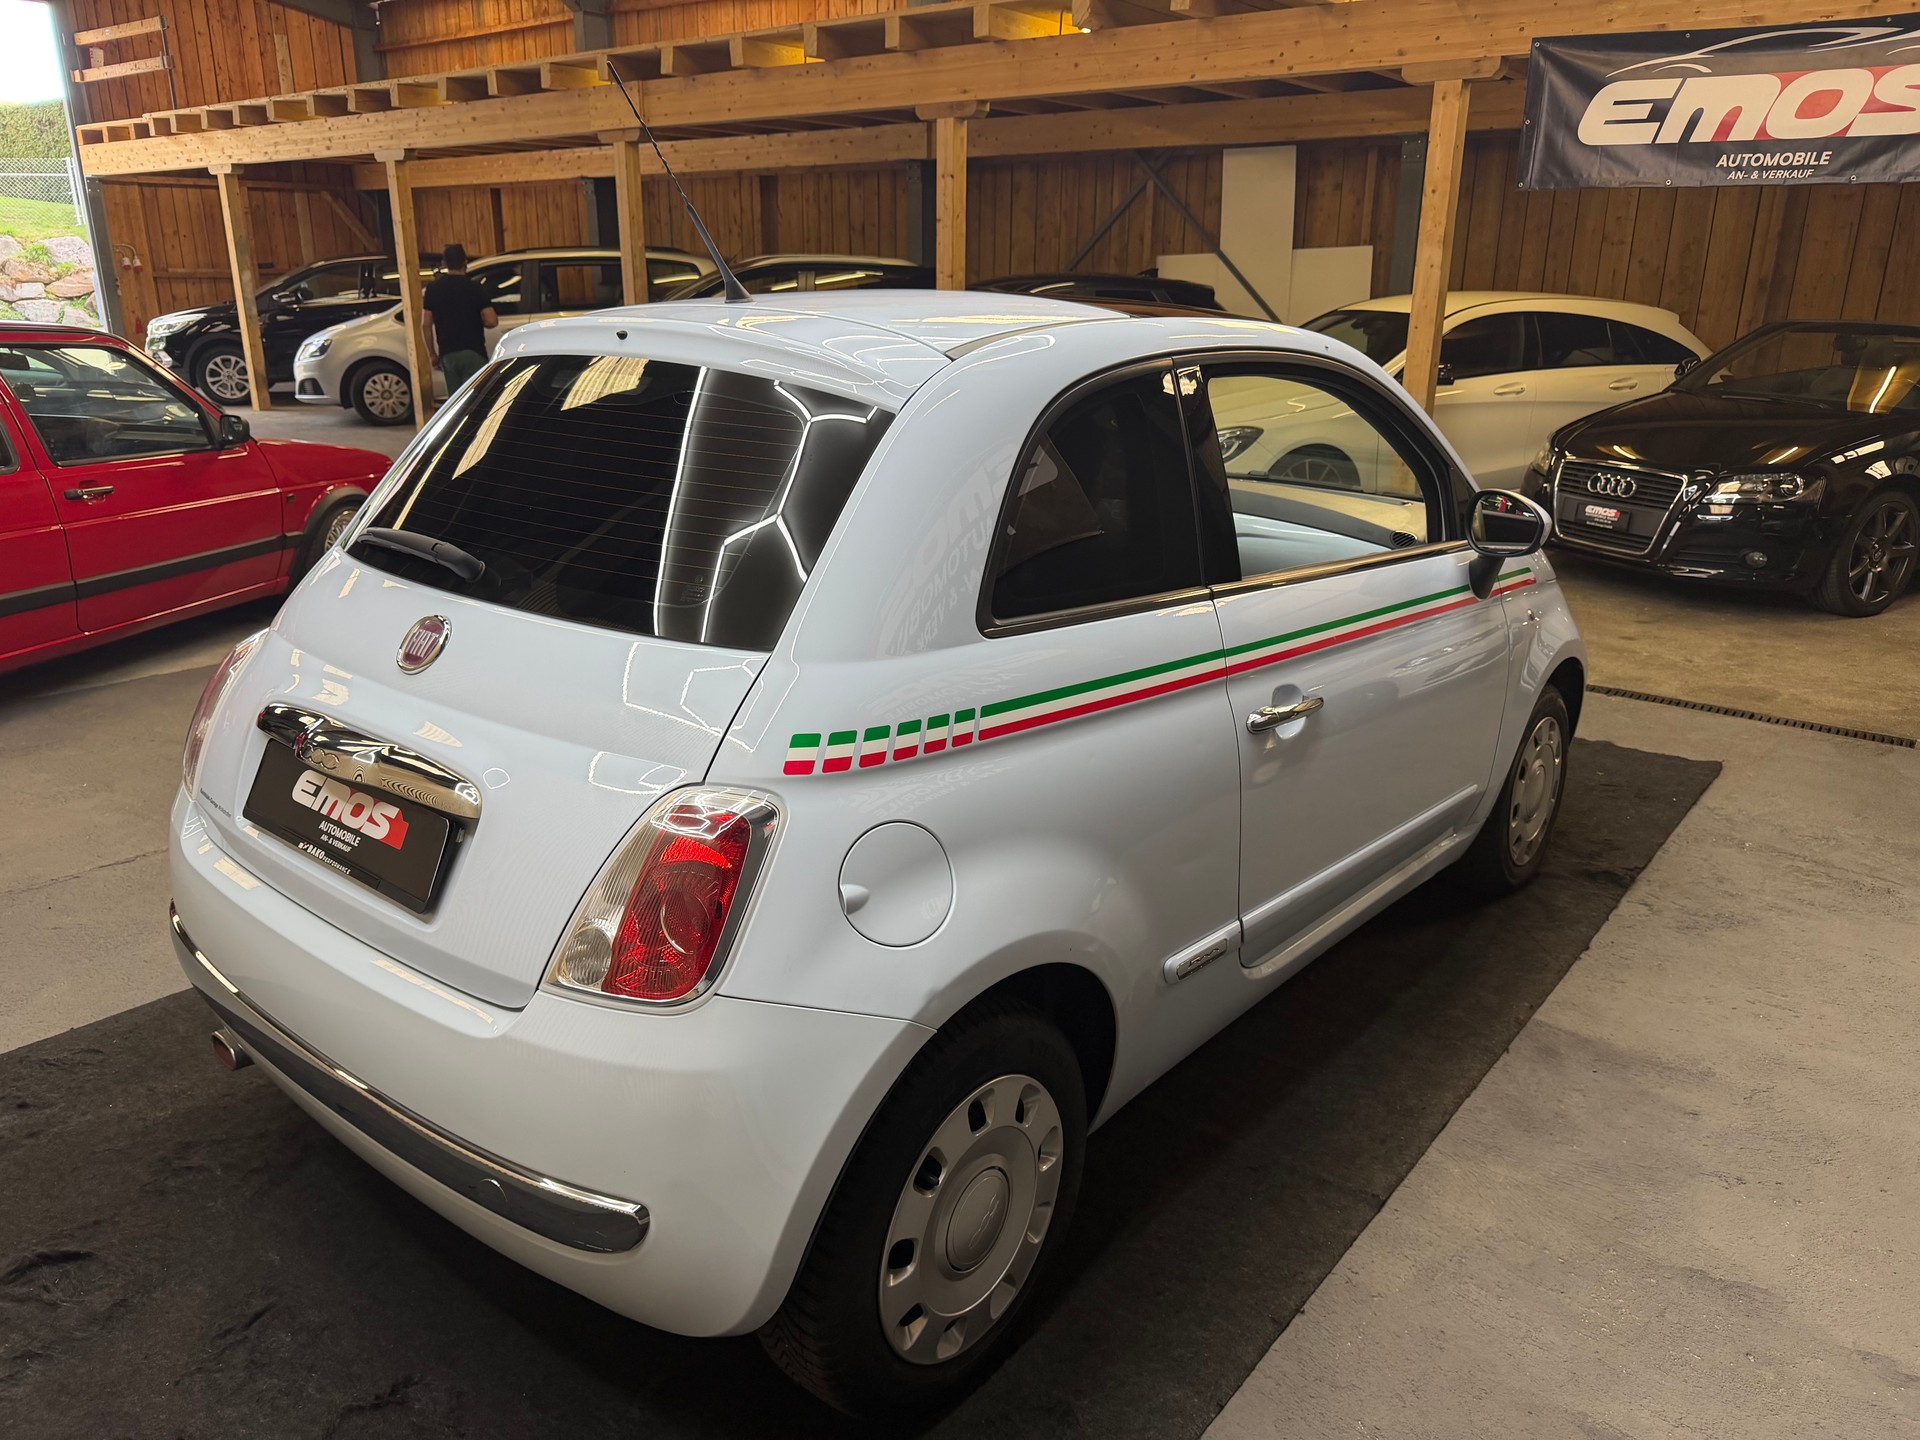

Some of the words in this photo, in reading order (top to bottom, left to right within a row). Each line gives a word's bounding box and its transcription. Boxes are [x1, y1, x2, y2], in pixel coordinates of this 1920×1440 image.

[1715, 150, 1833, 168] AUTOMOBILE
[1727, 170, 1749, 180] AN-
[1750, 170, 1759, 180] &
[1761, 168, 1815, 180] VERKAUF
[405, 629, 440, 658] FIAT
[291, 769, 403, 840] EMOS
[318, 820, 361, 847] AUTOMOBILE
[332, 839, 353, 853] VERKAUF
